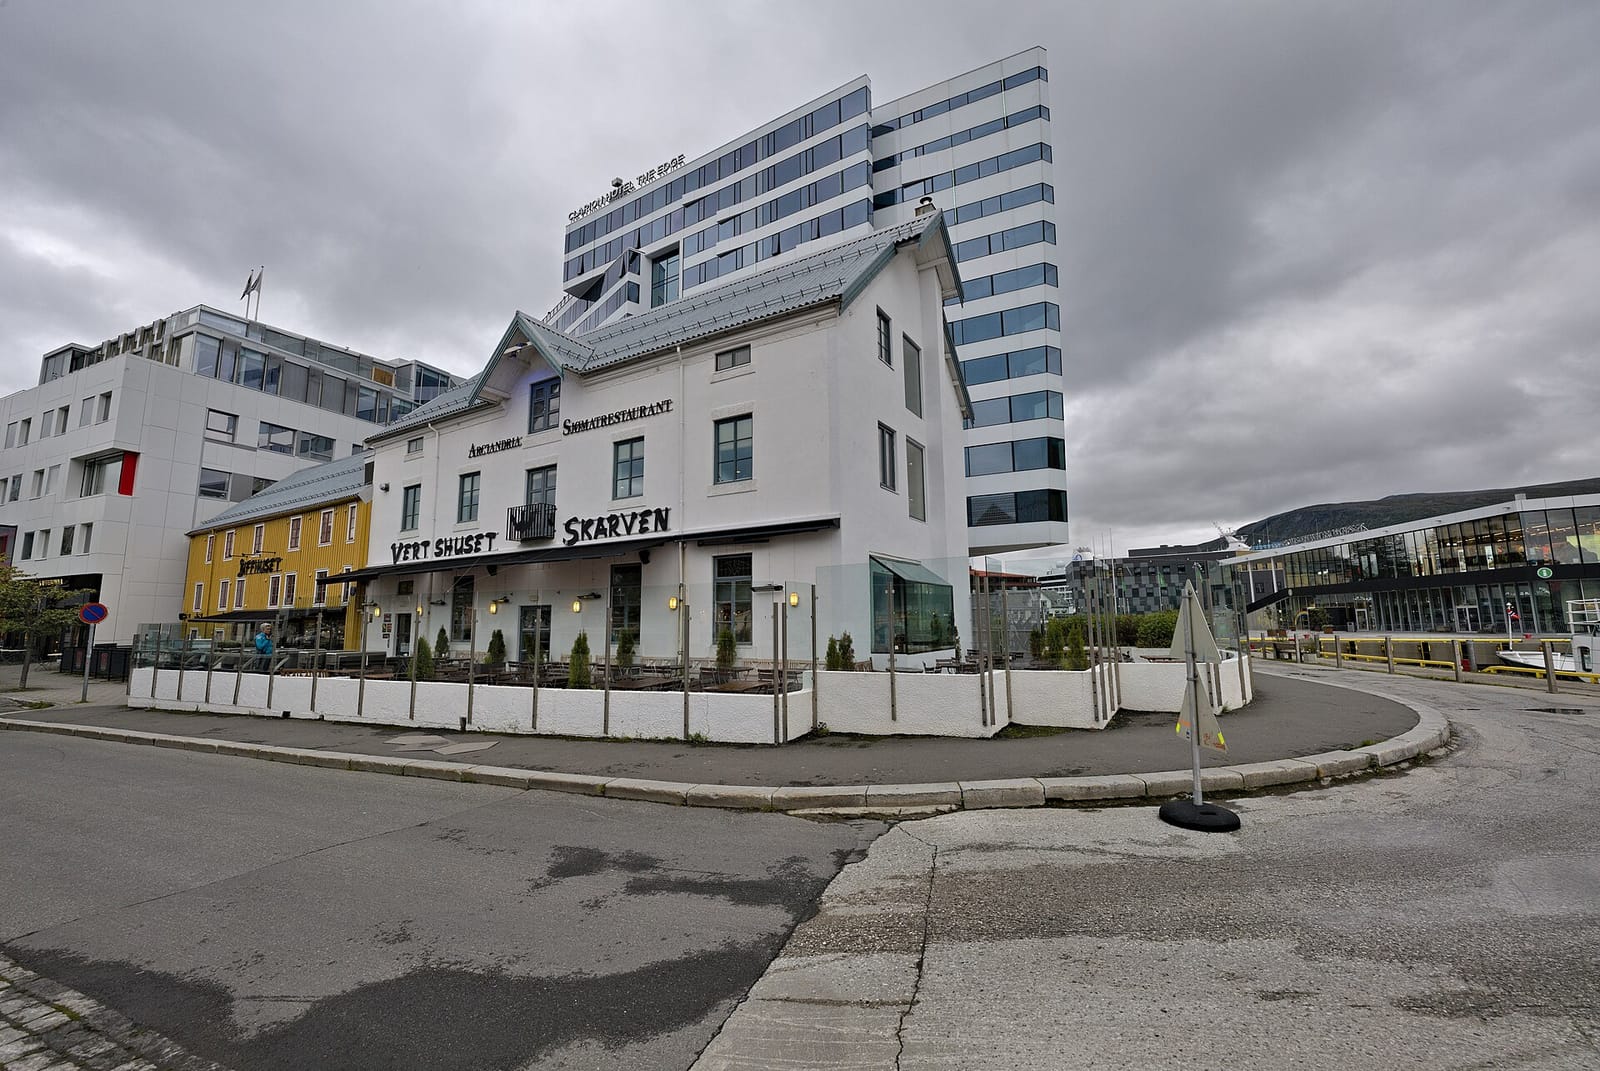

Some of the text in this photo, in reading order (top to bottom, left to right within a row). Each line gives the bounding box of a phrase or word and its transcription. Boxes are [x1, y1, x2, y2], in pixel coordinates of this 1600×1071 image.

[568, 153, 686, 221] CLARION HOTEL THE EDGE
[562, 507, 671, 547] SKARVEN
